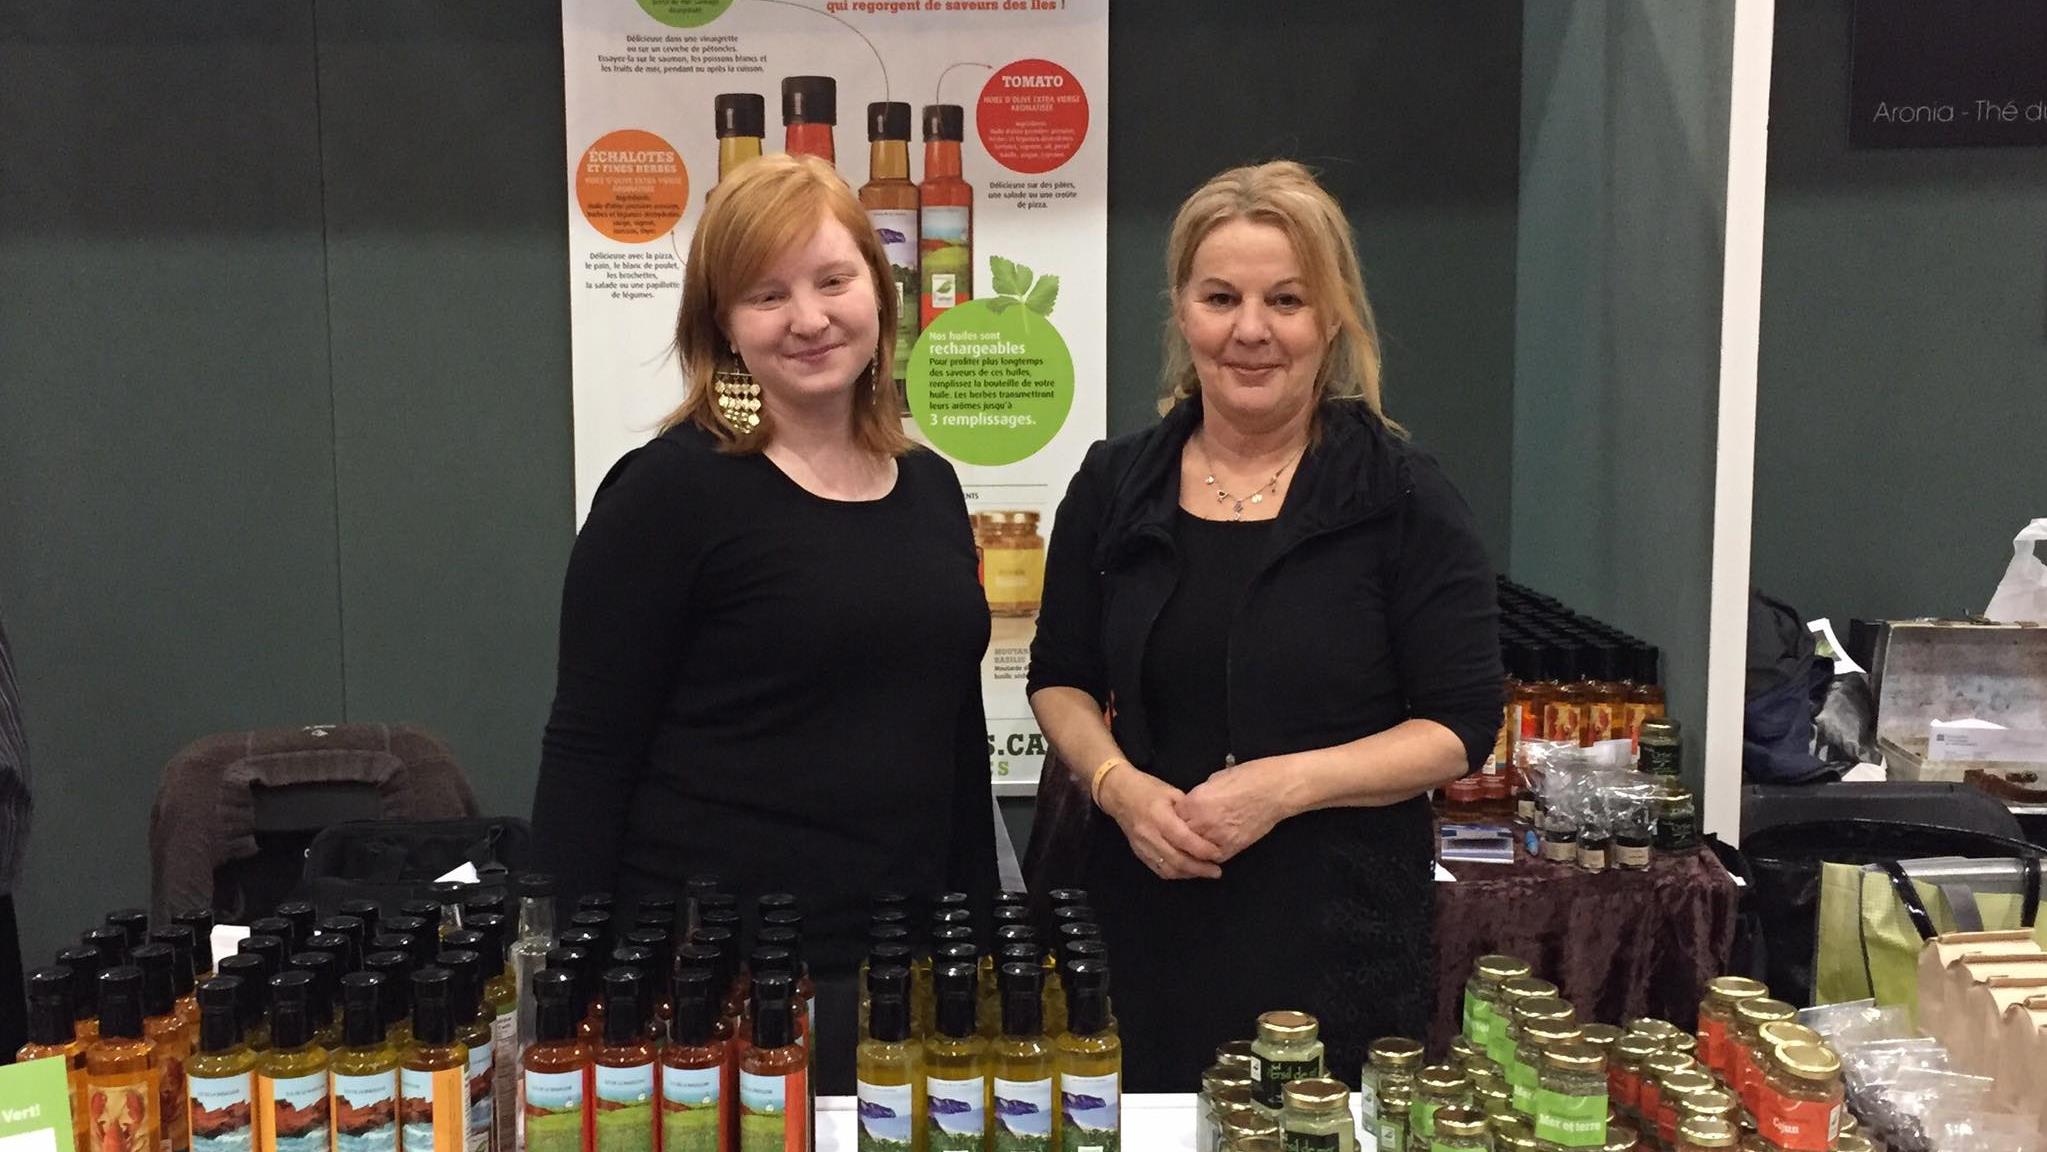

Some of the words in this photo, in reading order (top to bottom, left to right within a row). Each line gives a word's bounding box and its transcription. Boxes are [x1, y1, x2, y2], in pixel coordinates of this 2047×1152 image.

[827, 1, 848, 13] qui
[852, 0, 920, 13] regorgent
[925, 0, 941, 10] de
[946, 1, 998, 10] saveurs
[1003, 0, 1026, 10] des
[626, 34, 662, 42] Délicieuse
[700, 35, 738, 44] vinaigrette
[1002, 76, 1064, 87] TOMATO
[1873, 101, 1954, 123] Aronia
[1976, 100, 2019, 122] Thé
[2025, 101, 2047, 121] d
[589, 147, 675, 163] ÉCHALOTES
[586, 164, 601, 173] ET
[602, 164, 634, 173] FINES
[636, 164, 677, 173] HERBES
[989, 181, 1025, 189] Délicieuse
[1040, 181, 1053, 189] des
[1003, 191, 1026, 199] salade
[590, 252, 626, 260] Délicieuse
[929, 332, 946, 340] Nos
[949, 332, 977, 340] huiles
[980, 332, 1000, 340] sont
[929, 342, 1026, 357] rechargeables
[950, 358, 979, 367] profiter
[982, 358, 999, 367] plus
[1001, 358, 1044, 367] longtemps
[929, 368, 943, 376] des
[978, 368, 988, 376] de
[1005, 368, 1032, 377] huiles,
[929, 379, 972, 388] remplissez
[974, 379, 982, 387] la
[983, 379, 1019, 387] bouteille
[1021, 379, 1031, 387] de
[1034, 380, 1055, 388] votre
[929, 390, 952, 398] huile.
[954, 390, 967, 398] Les
[969, 390, 997, 398] herbes
[929, 401, 949, 409] leurs
[982, 401, 1013, 411] jusqu'à
[929, 414, 938, 426] 3
[942, 413, 1037, 428] remplissages.
[1539, 1113, 1560, 1127] Mer
[1773, 1117, 1800, 1135] Cajun
